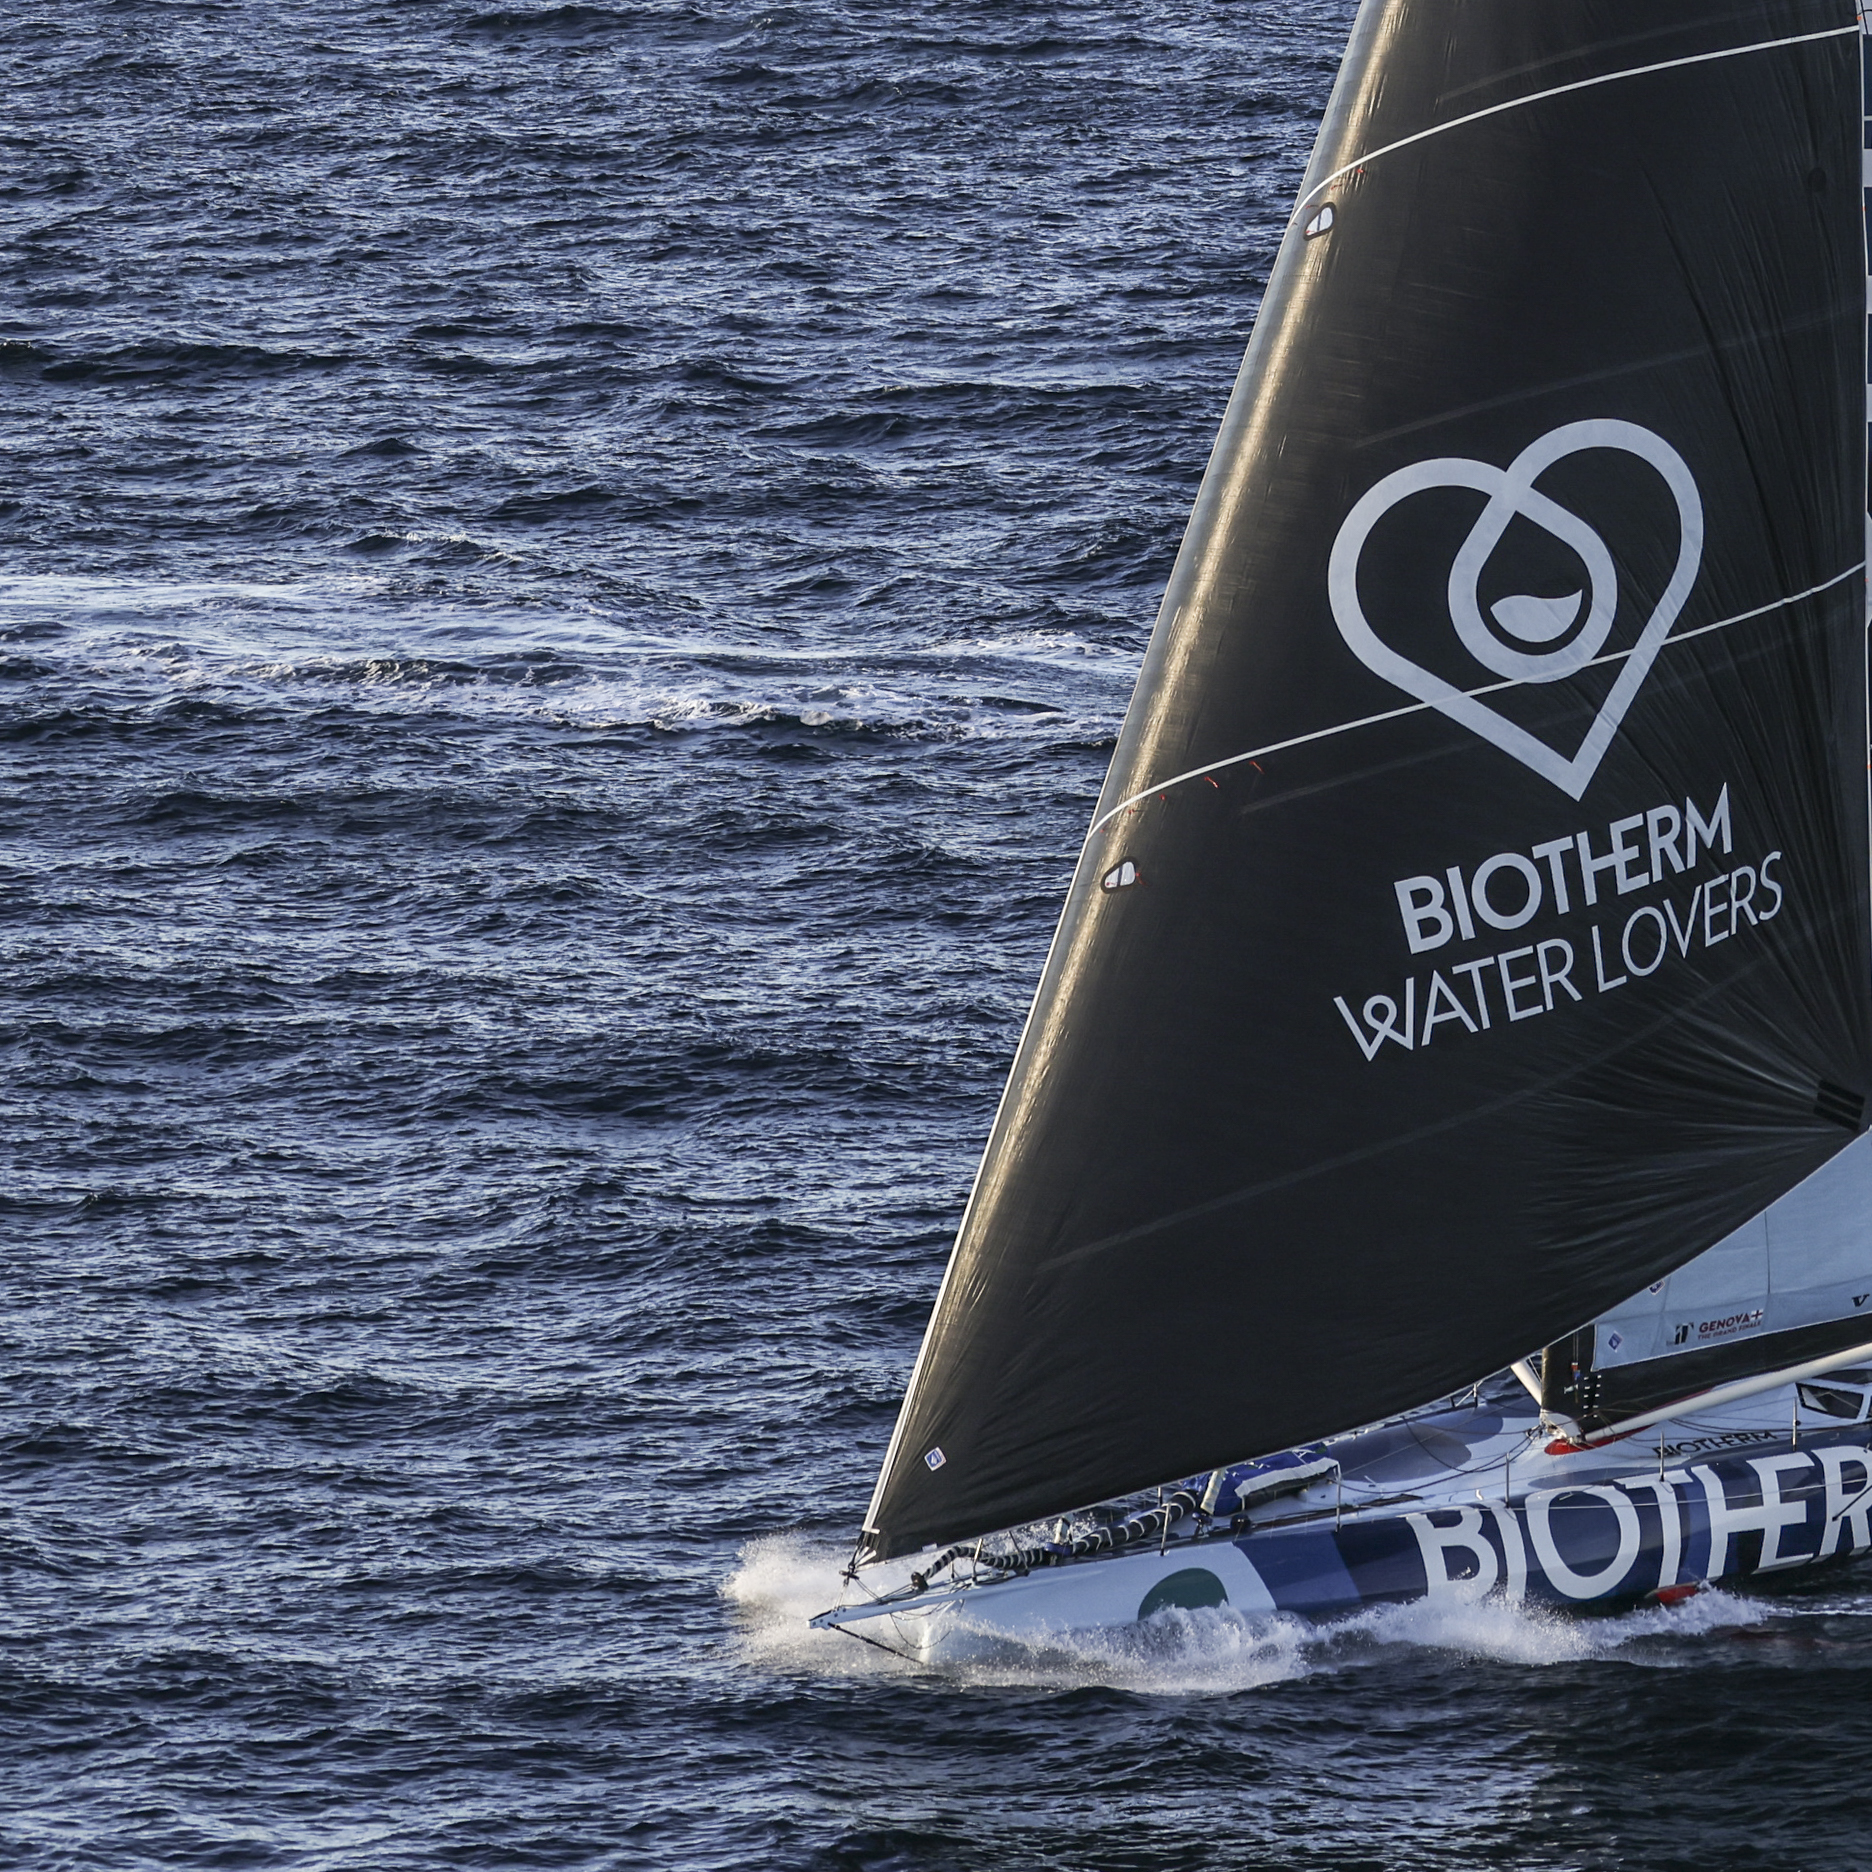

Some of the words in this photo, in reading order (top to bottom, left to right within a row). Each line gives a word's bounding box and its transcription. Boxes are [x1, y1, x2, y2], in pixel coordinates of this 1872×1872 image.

[1394, 782, 1734, 955] BIOTHERM
[1334, 938, 1583, 1062] WATER
[1594, 850, 1782, 993] LOVERS
[1699, 1313, 1749, 1333] GENOVA
[1652, 1430, 1779, 1459] BIOTHERM
